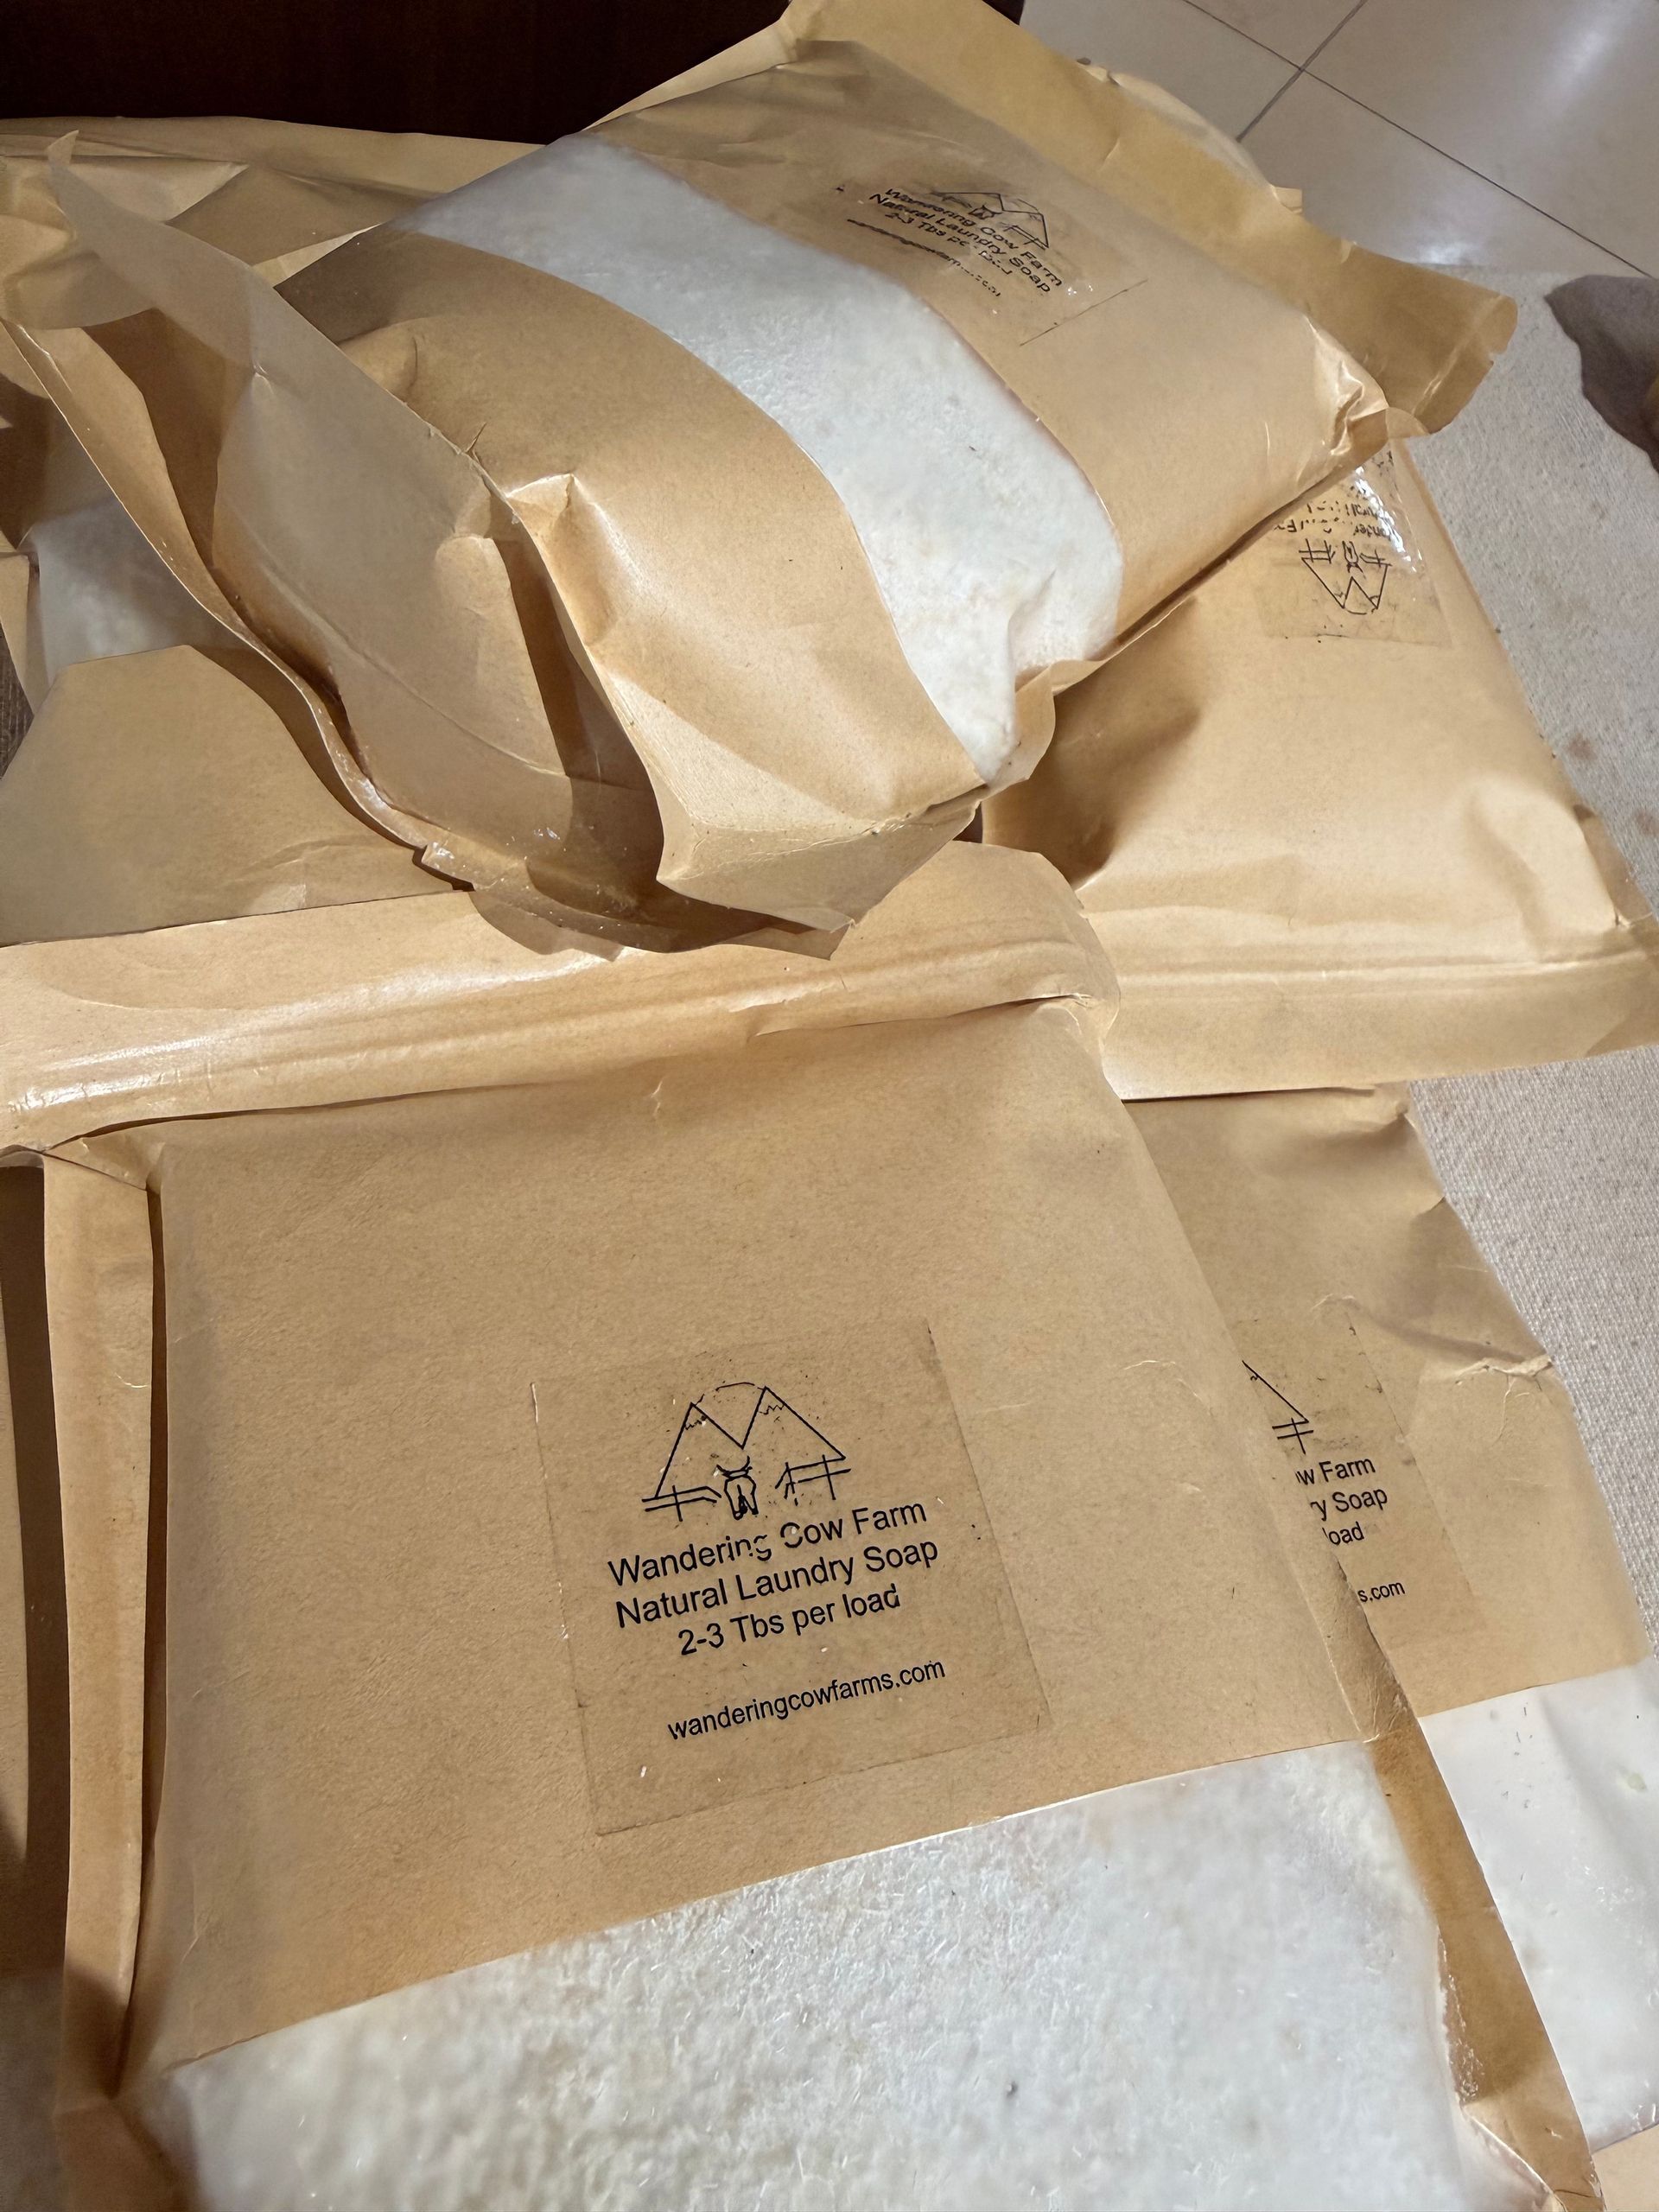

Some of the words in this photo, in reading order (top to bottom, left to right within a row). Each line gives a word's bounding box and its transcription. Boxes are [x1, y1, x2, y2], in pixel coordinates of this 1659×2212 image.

[936, 217, 1007, 255] Laundry
[1009, 257, 1051, 292] Soap
[946, 235, 977, 250] pe
[980, 226, 1019, 250] Cow
[1020, 251, 1063, 287] Farm
[1319, 1458, 1376, 1483] Farm
[1332, 1488, 1388, 1512] Soap
[608, 1534, 772, 1586] Wandering
[780, 1517, 842, 1548] Cow
[852, 1503, 927, 1535] Farm
[616, 1577, 728, 1628] Natural
[735, 1556, 855, 1600] Laundry
[864, 1540, 938, 1573] Soap
[677, 1623, 724, 1656] 2-3
[730, 1612, 785, 1642] Tbs
[792, 1600, 836, 1635] per
[842, 1583, 900, 1618] load
[668, 1659, 946, 1740] wanderingcowfarms.com
